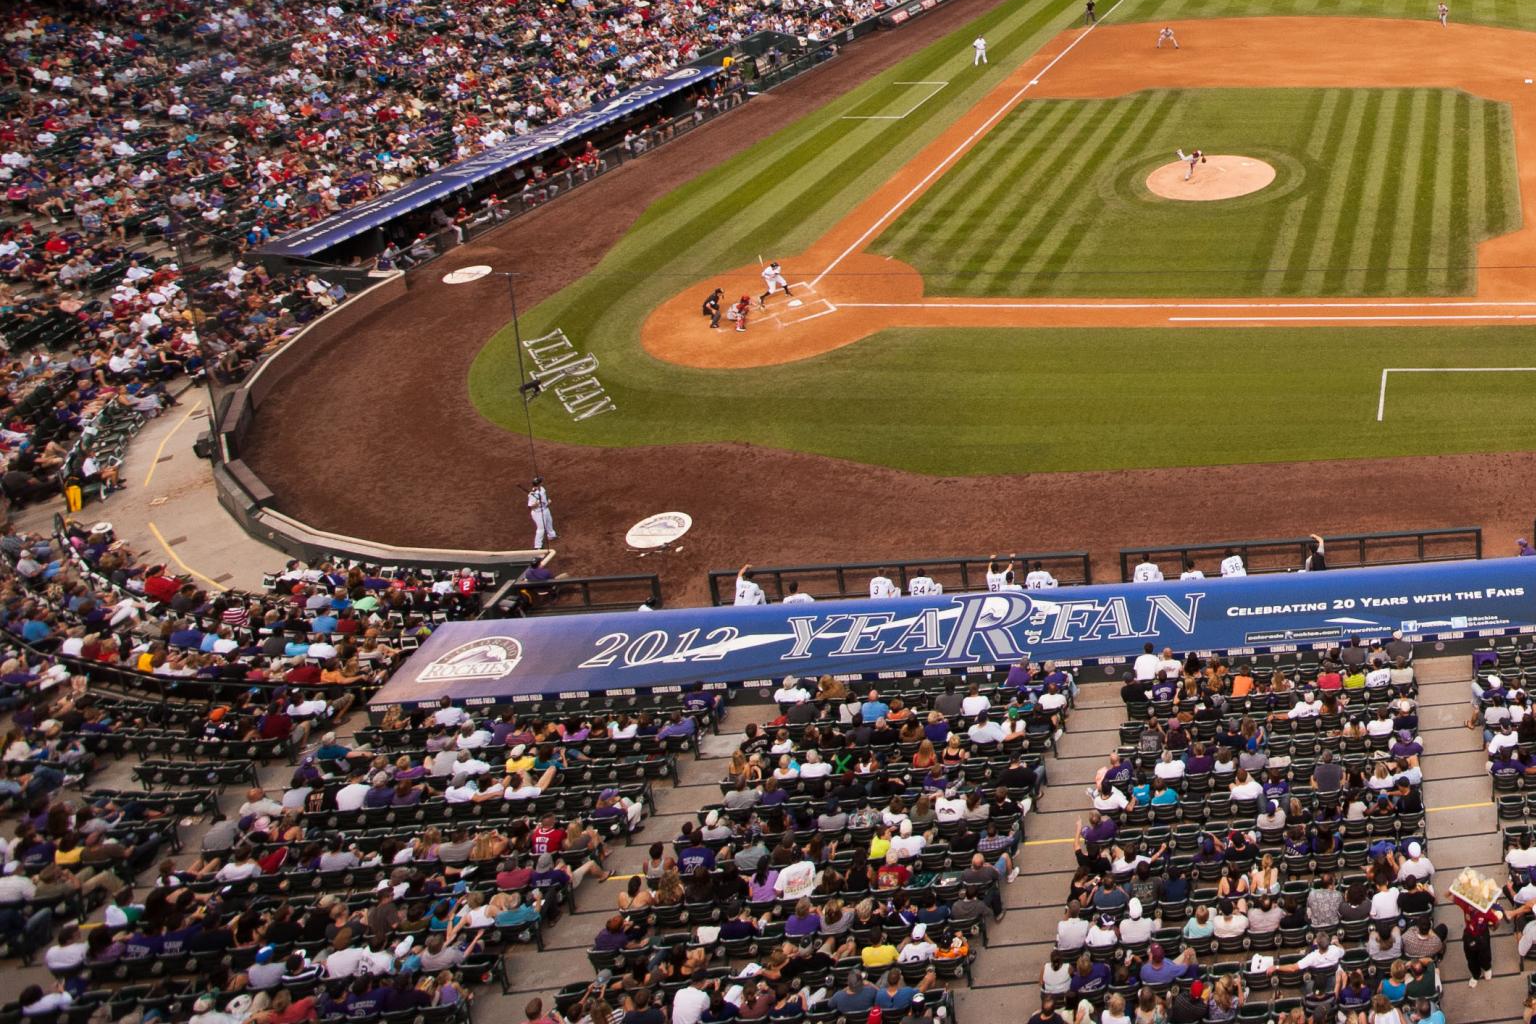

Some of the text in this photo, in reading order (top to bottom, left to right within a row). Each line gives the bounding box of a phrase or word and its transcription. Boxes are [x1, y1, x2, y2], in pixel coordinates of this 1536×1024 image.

[1230, 562, 1241, 573] 36
[1143, 571, 1149, 581] 5
[463, 582, 470, 591] 2
[873, 585, 879, 595] 3
[913, 586, 925, 595] 24
[1032, 581, 1041, 590] 14
[739, 589, 745, 599] 4
[1227, 586, 1525, 617] CELEBRATING 20 YEARS WITH THE FANS
[780, 591, 1031, 666] YEAR
[1042, 592, 1206, 644] FAN
[577, 626, 739, 669] 2012
[428, 660, 515, 677] ROCKIES
